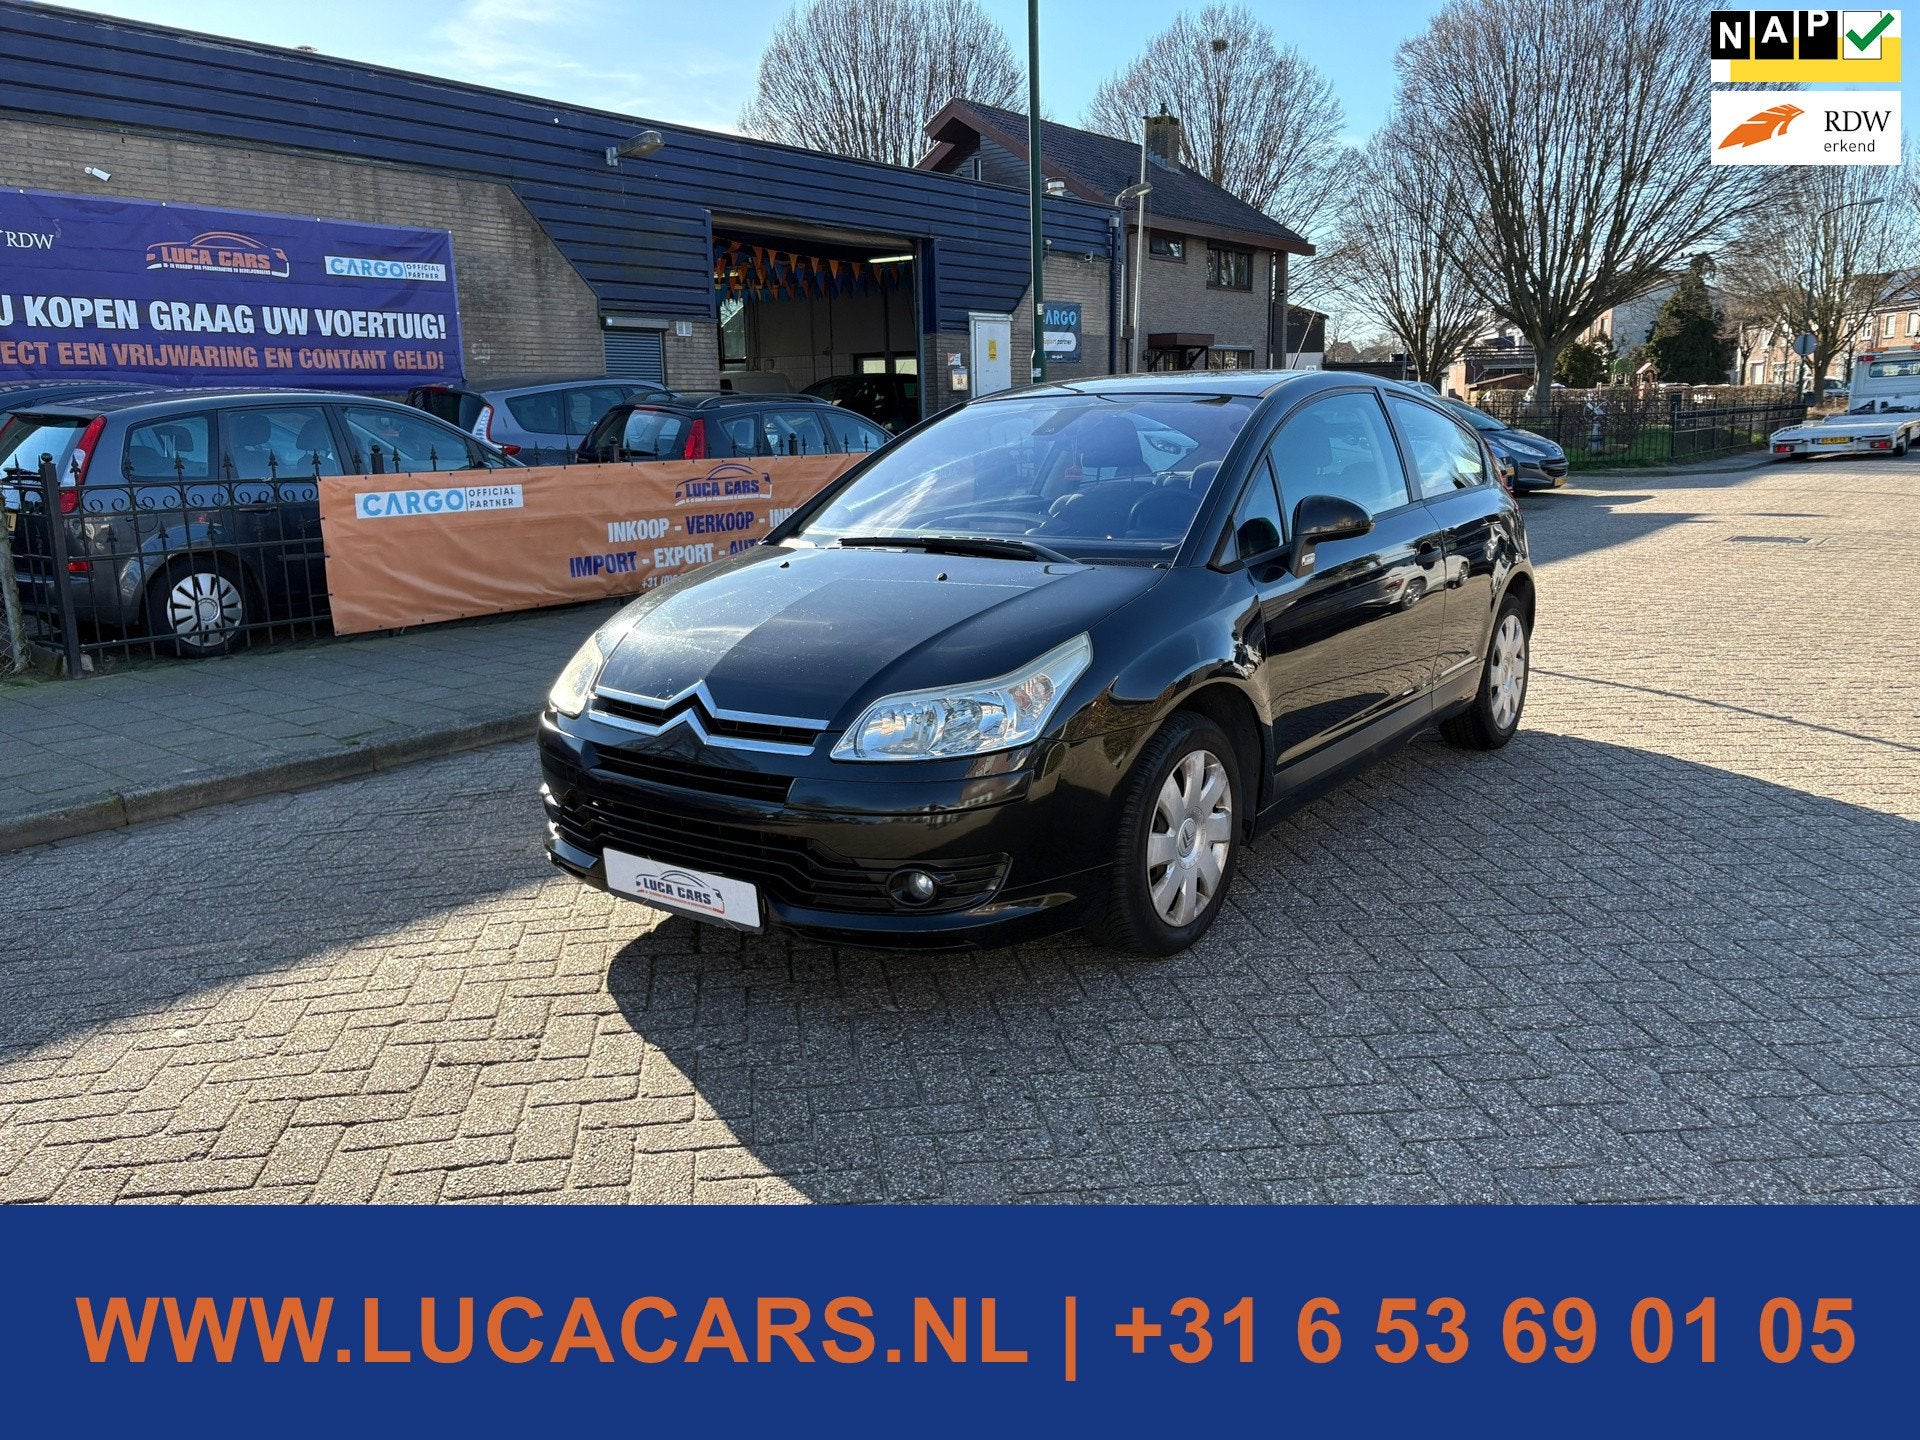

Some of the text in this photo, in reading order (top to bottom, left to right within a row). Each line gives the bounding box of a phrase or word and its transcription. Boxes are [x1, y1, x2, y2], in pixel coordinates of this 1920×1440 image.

[5, 231, 54, 249] RDW
[161, 246, 213, 265] LUCA
[218, 251, 271, 269] CARS
[330, 258, 404, 277] CARGO
[406, 263, 440, 272] OFFICIAL
[407, 272, 439, 280] PARTNER
[23, 295, 140, 330] KOPEN
[149, 300, 255, 334] GRAAG
[261, 306, 309, 336] UW
[315, 309, 447, 340] VOERTUIG!
[1043, 309, 1076, 326] ARGO
[0, 341, 445, 370] ECT EEN VRIJWARING EN CONTANT GELD!
[468, 487, 515, 497] OFFICIAL
[685, 479, 760, 497] LUCA CARS
[363, 489, 464, 516] CARGO
[469, 498, 514, 508] PARTNER
[607, 517, 670, 543] INKOOP
[685, 511, 754, 535] VERKOOP
[569, 551, 637, 578] IMPORT
[653, 543, 714, 569] EXPORT
[643, 877, 674, 895] LUCA
[677, 886, 712, 905] CARS
